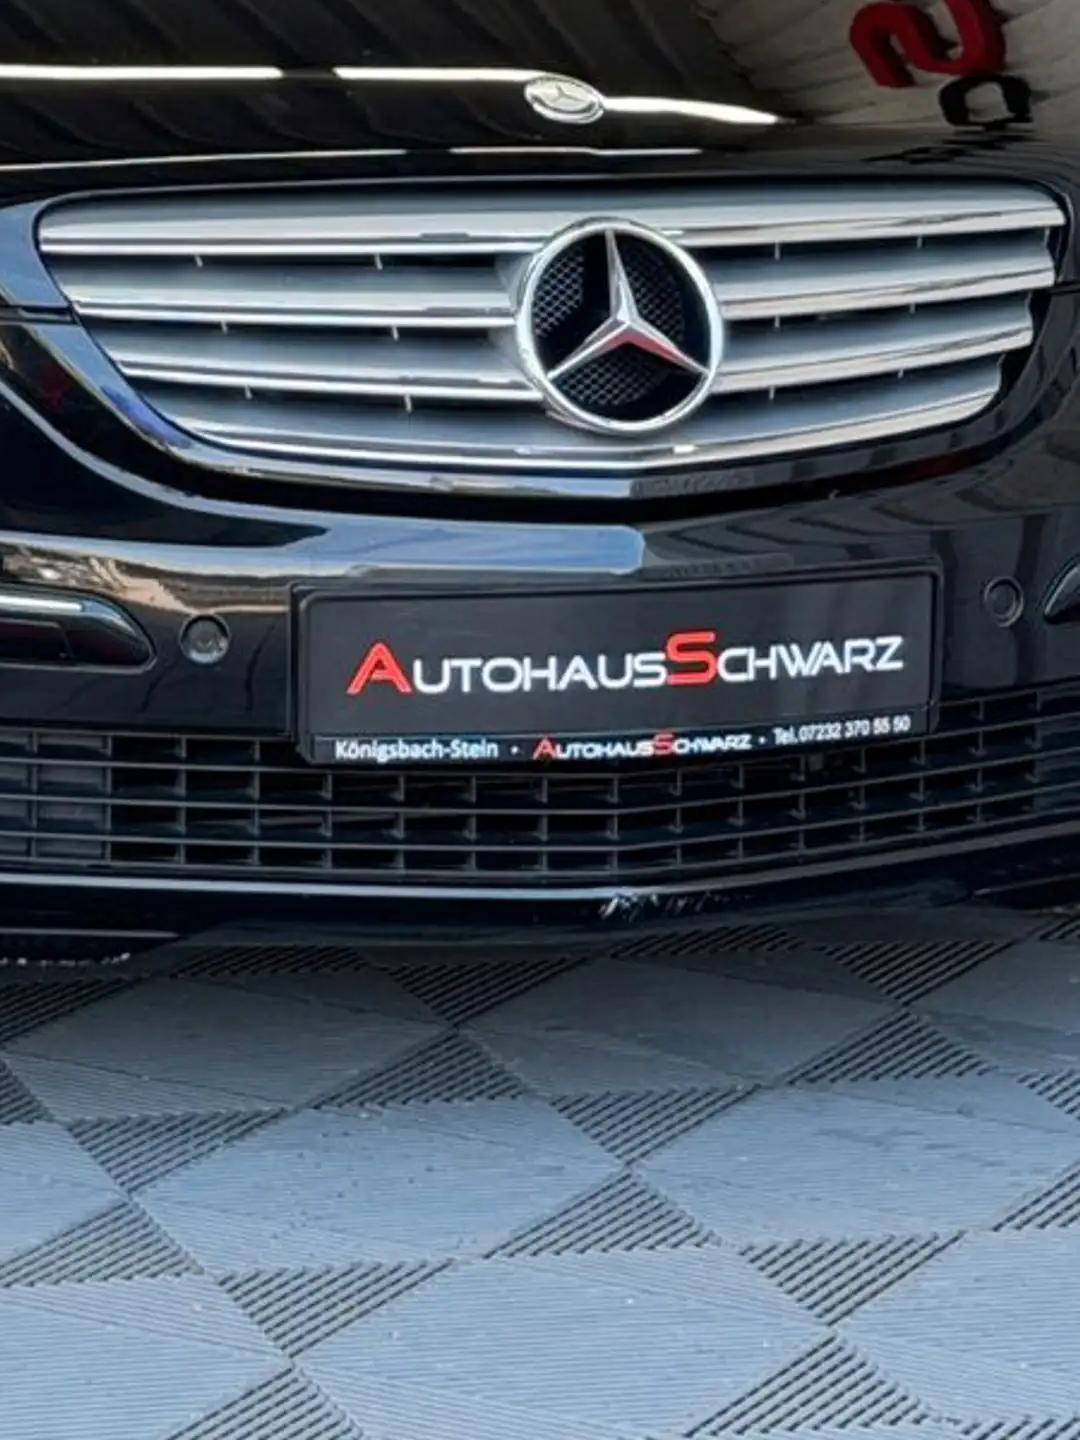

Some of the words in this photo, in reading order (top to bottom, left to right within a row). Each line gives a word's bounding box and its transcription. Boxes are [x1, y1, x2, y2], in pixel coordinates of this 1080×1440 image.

[346, 630, 904, 695] AUTOHAUSSCHWARZ
[335, 737, 499, 763] Königsbach-Stein
[843, 718, 871, 739] 370
